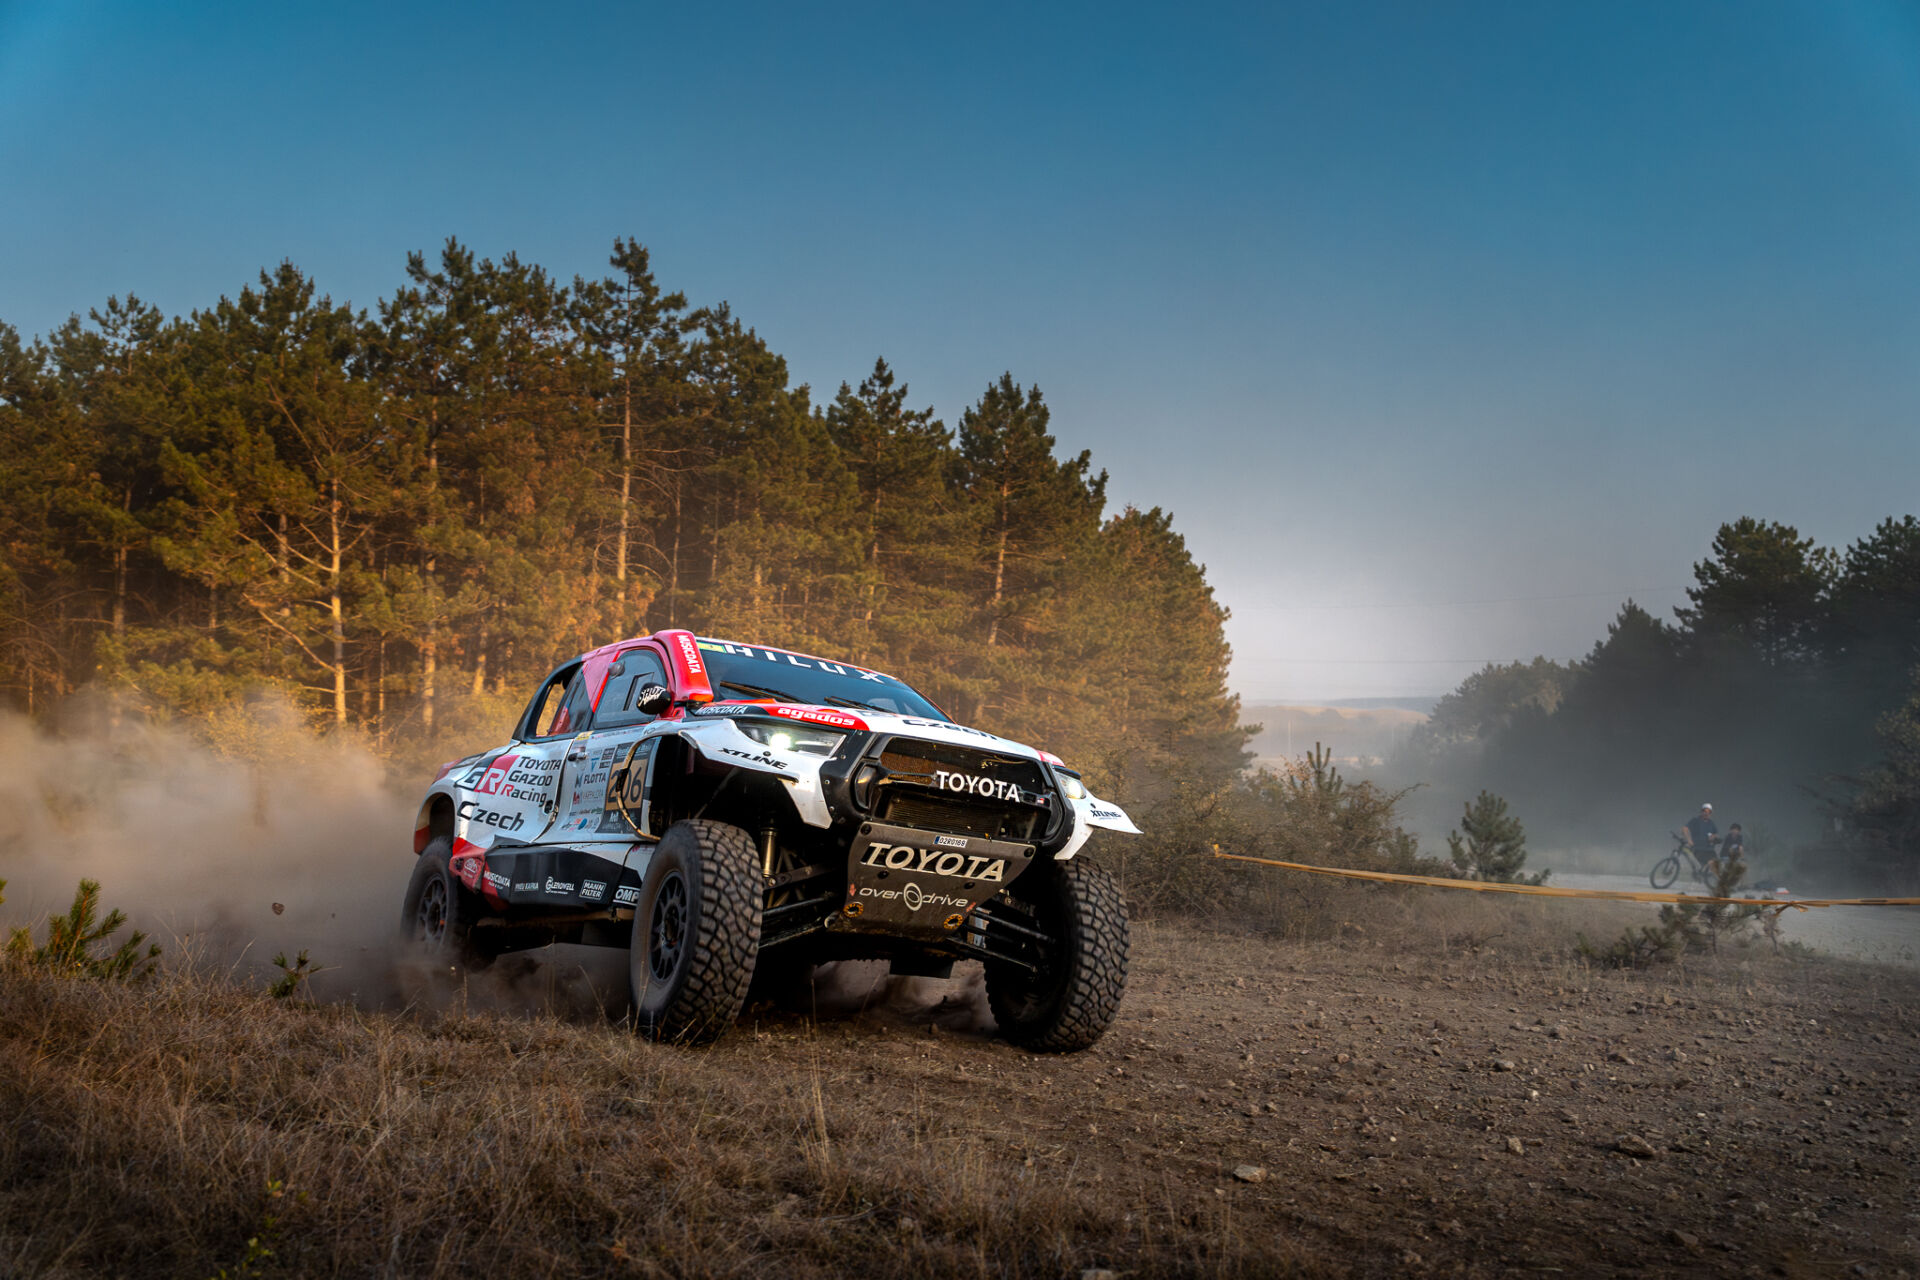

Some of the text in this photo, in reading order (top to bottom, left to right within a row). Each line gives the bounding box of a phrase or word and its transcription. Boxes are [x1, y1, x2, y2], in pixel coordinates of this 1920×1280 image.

[677, 634, 701, 674] MUSICDATA
[724, 644, 885, 684] HILUX
[695, 705, 748, 716] MUSICDATA
[778, 706, 855, 727] agados
[518, 756, 563, 772] TOYOTA
[717, 748, 788, 770] XTLINE
[508, 770, 553, 787] GAZOO
[583, 772, 607, 785] FLOTTA
[608, 767, 642, 804] 206
[936, 770, 1020, 803] TOYOTA
[501, 784, 548, 808] Racing
[457, 801, 525, 832] Czech
[866, 842, 1006, 882] TOYOTA
[581, 889, 602, 898] FILTER
[583, 882, 605, 892] MANN
[615, 889, 640, 903] OMP
